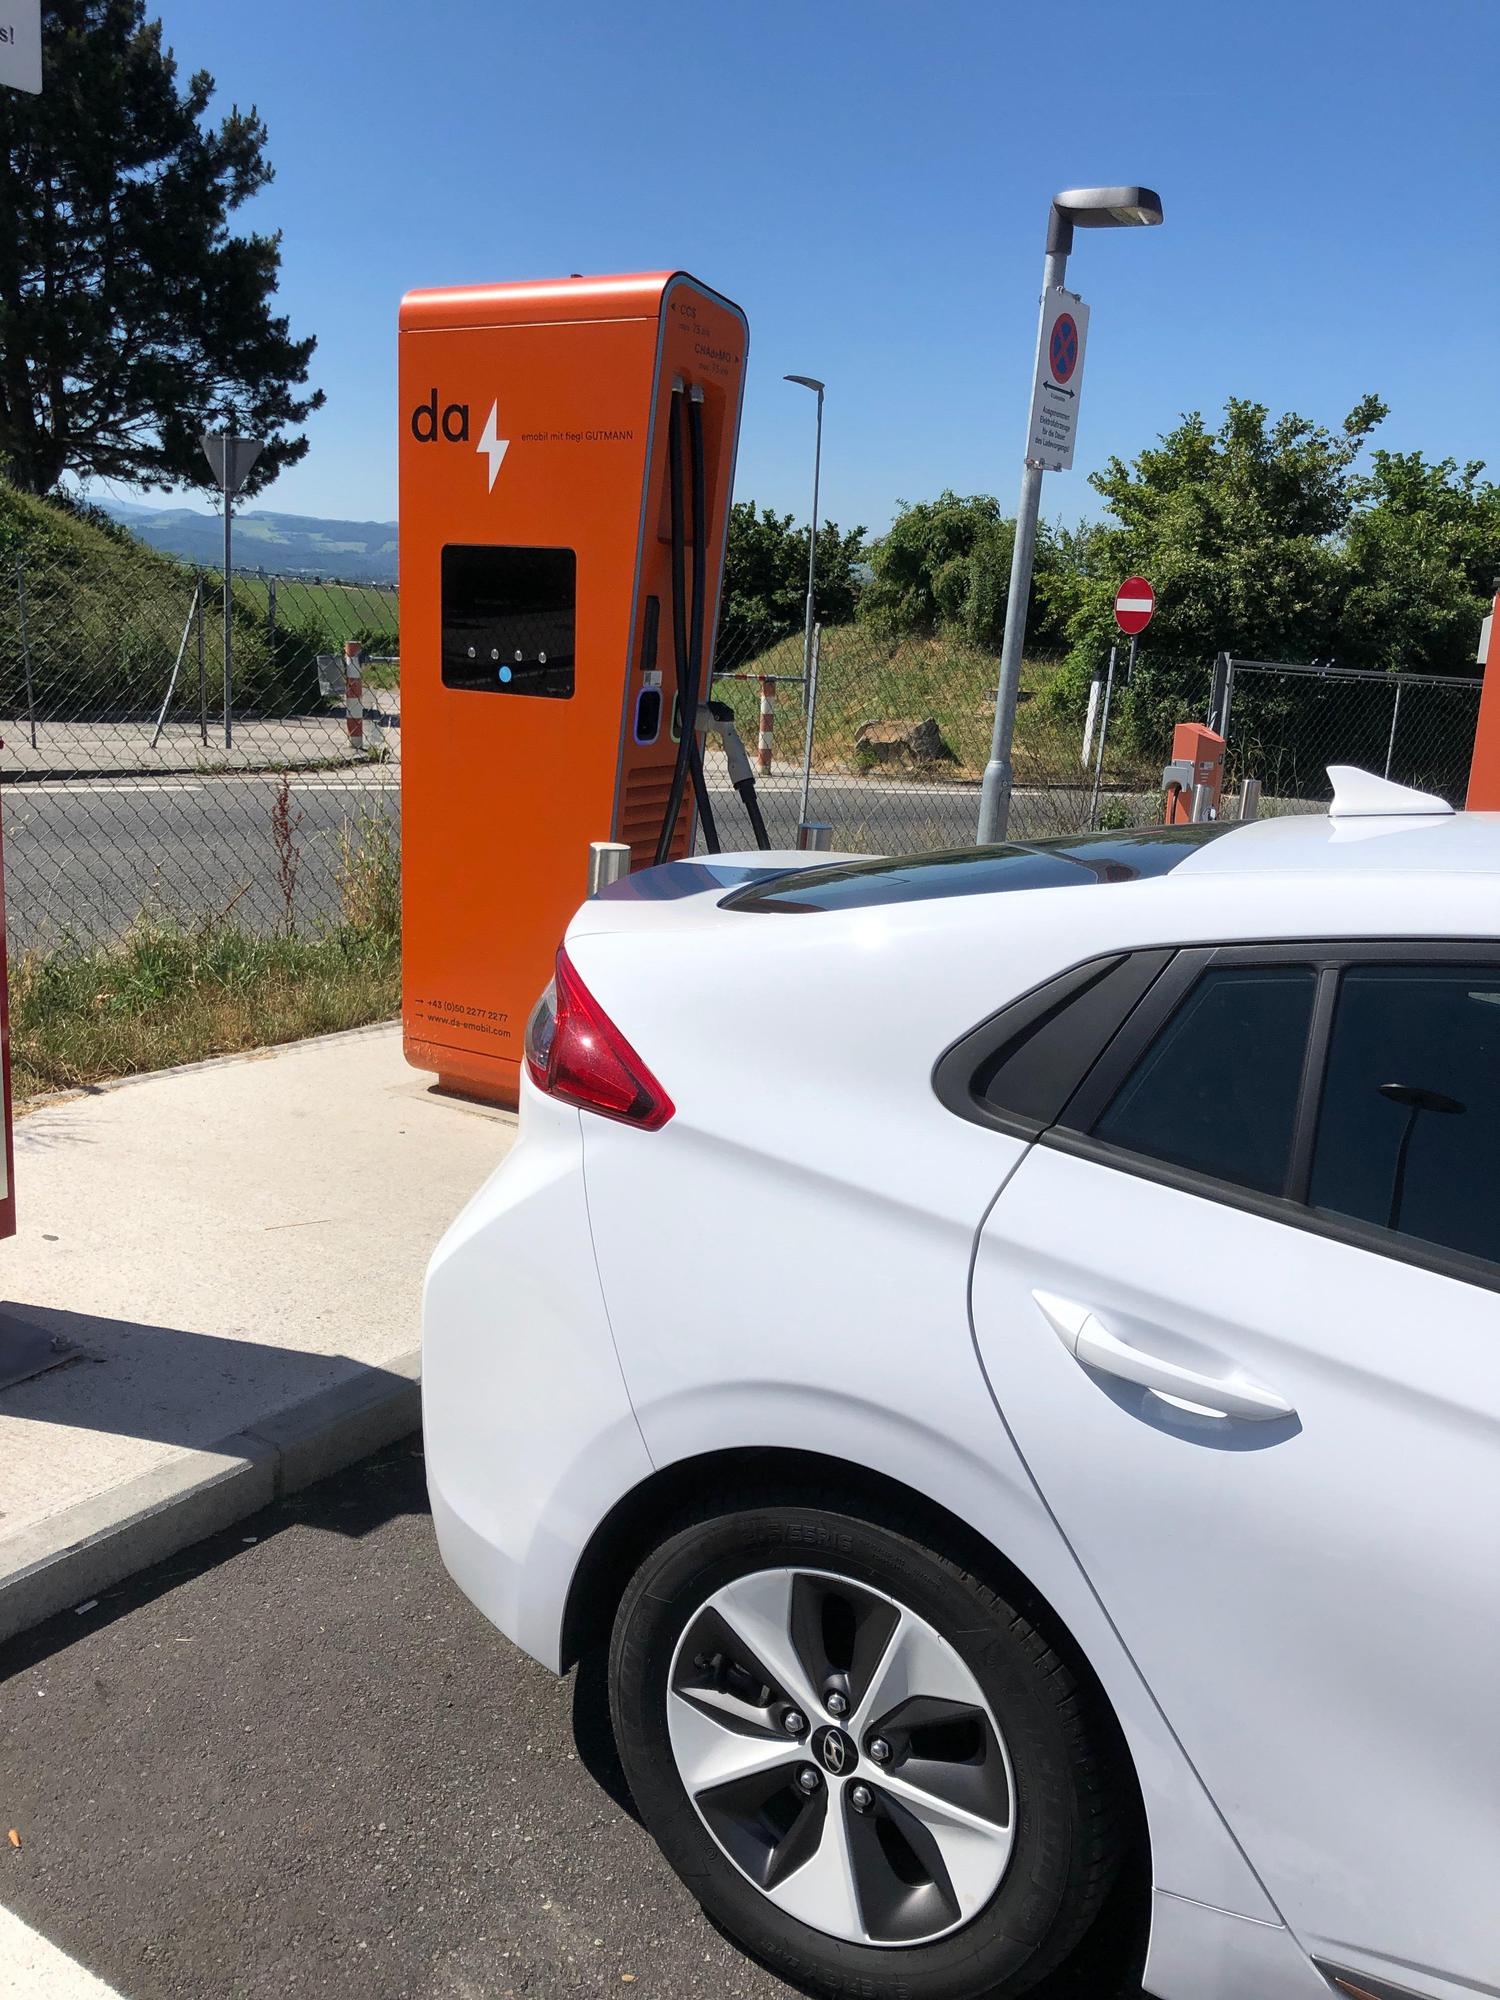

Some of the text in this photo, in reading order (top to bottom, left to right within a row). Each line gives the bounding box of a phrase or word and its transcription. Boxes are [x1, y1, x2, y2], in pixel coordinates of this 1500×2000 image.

[680, 304, 697, 319] CCS
[411, 388, 469, 442] da
[521, 431, 548, 441] emobil
[550, 431, 563, 441] mit
[585, 430, 633, 441] GUTMANN
[427, 1000, 508, 1022] +43 (0)50 2277 2277
[427, 1014, 511, 1038] www.da-emobil.com
